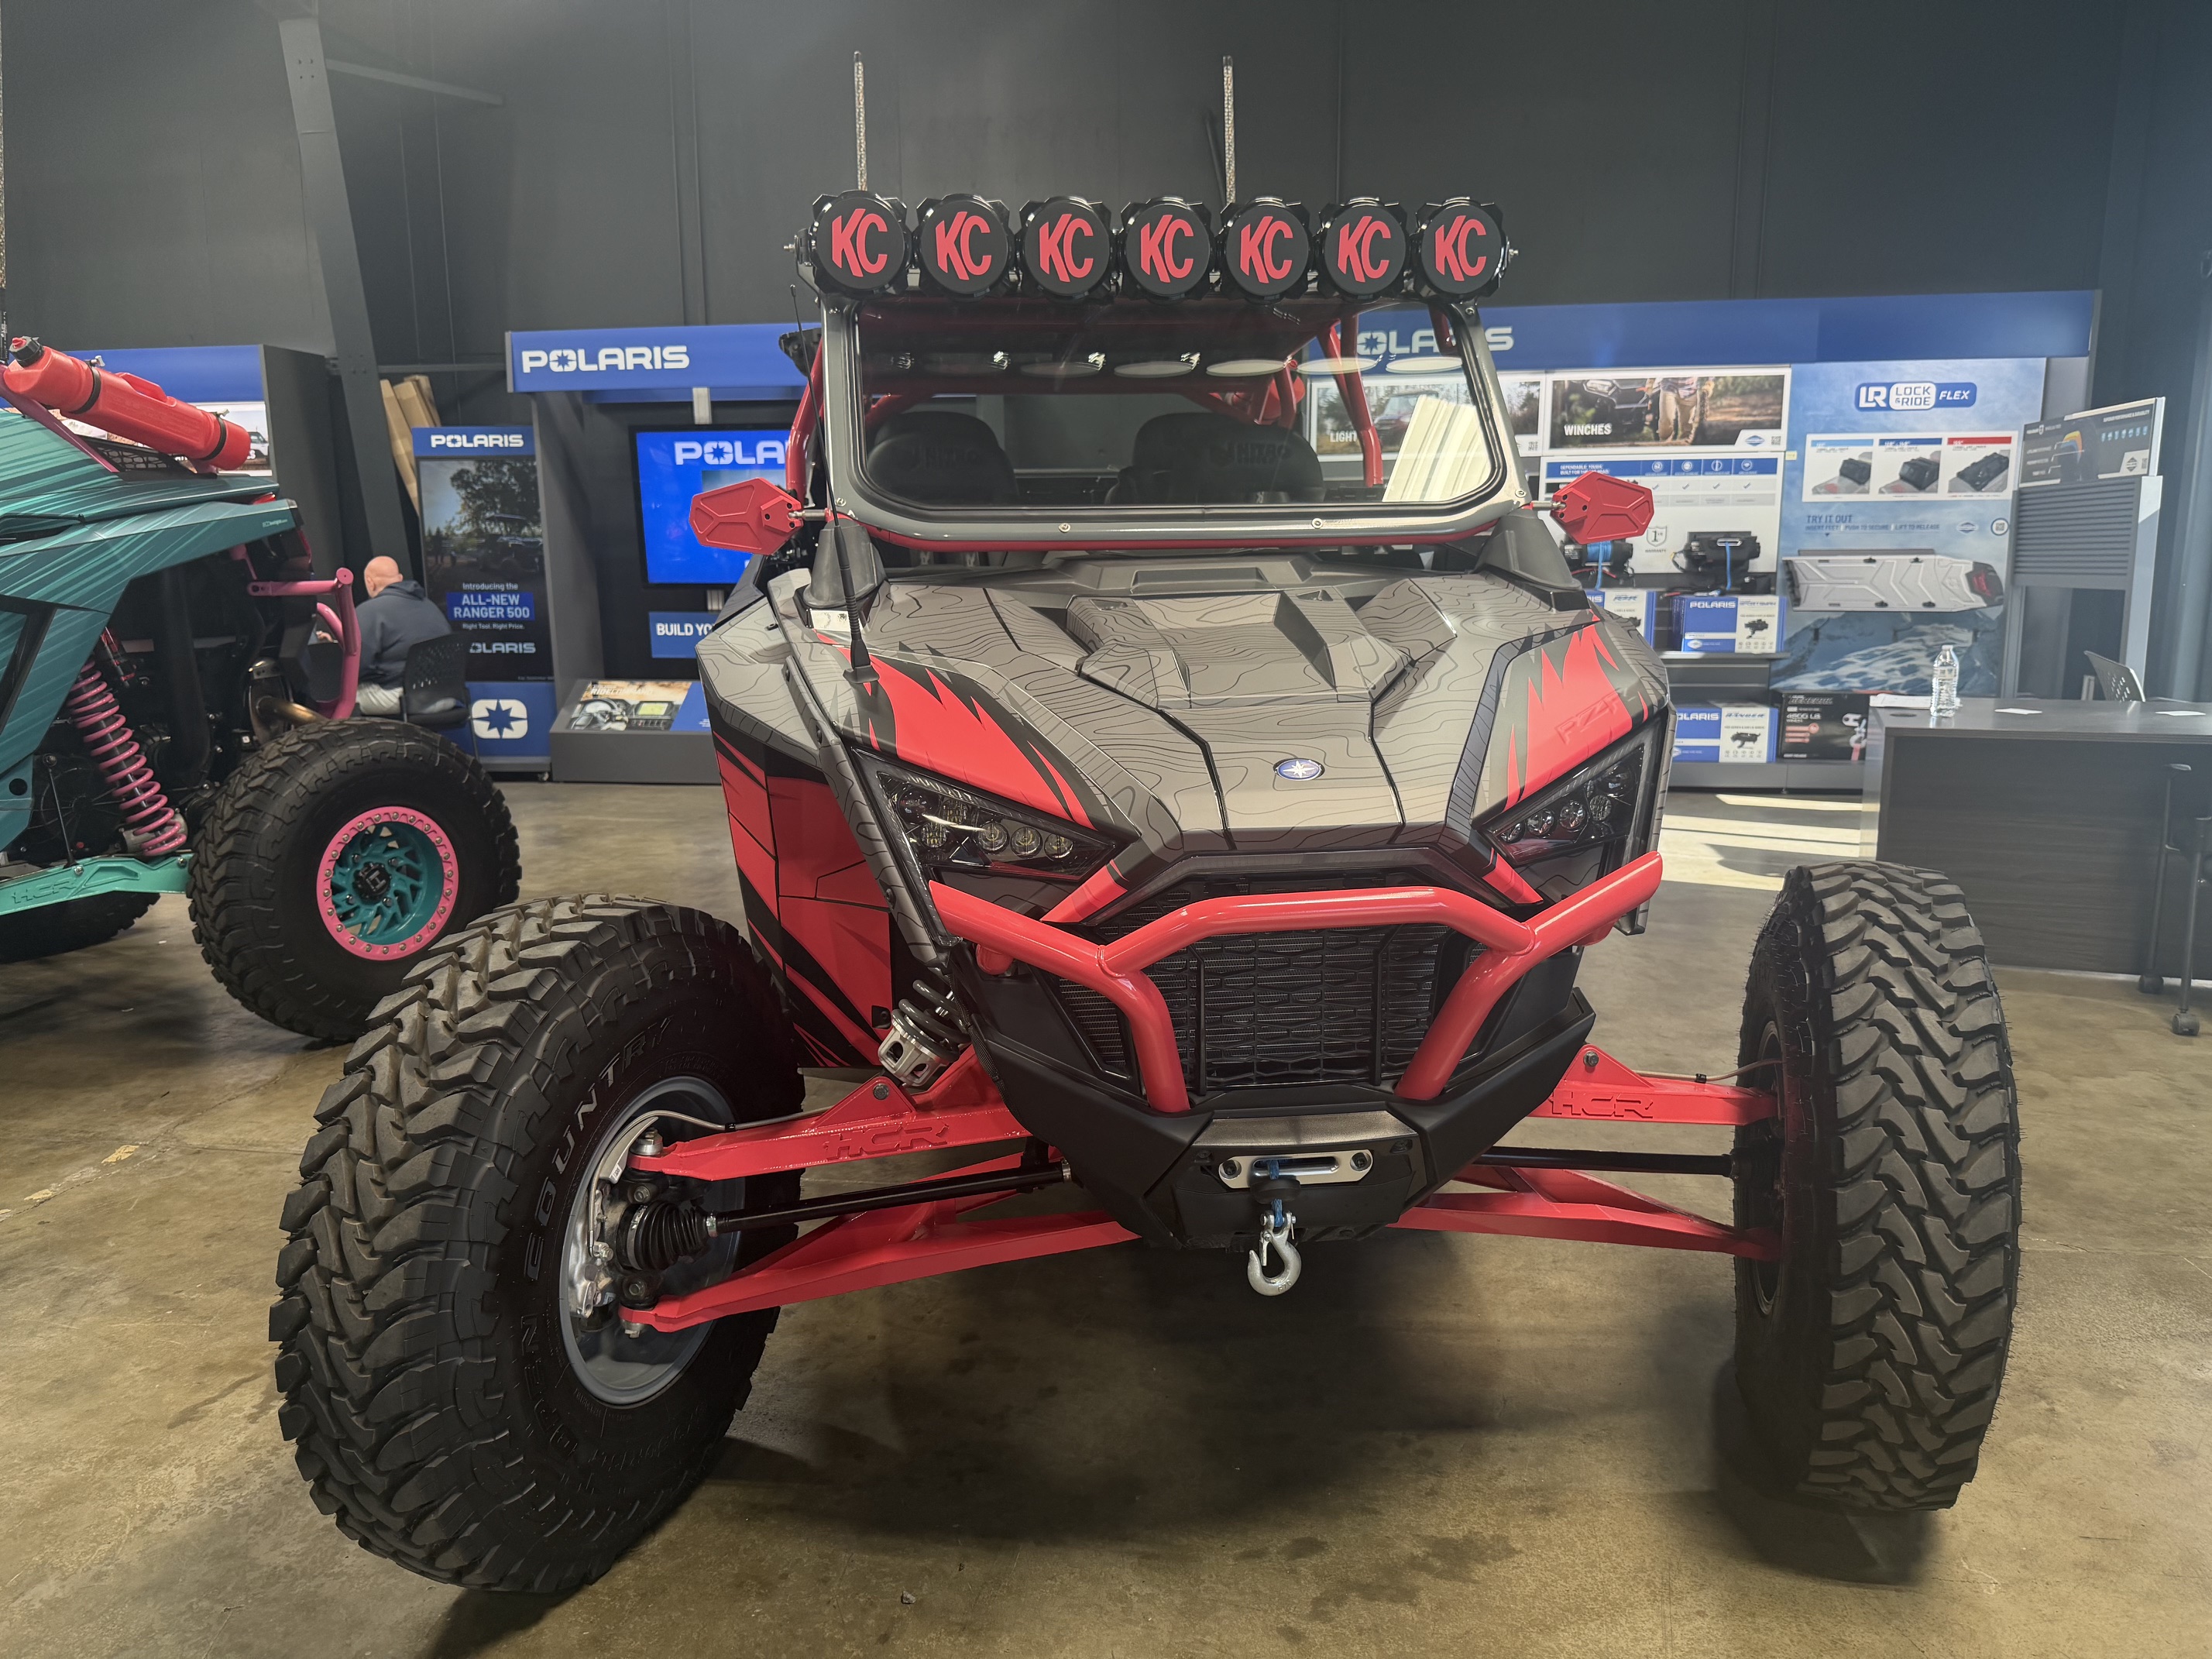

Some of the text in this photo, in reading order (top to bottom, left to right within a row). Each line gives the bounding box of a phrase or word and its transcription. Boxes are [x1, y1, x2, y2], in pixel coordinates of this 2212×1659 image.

[832, 209, 888, 277] KC
[936, 211, 992, 281] KC
[1039, 215, 1094, 283] KC
[1141, 215, 1194, 283] KC
[1338, 216, 1390, 283] KC
[1436, 216, 1487, 281] KC
[1241, 216, 1293, 284] KC
[1338, 325, 1515, 356] OLAS
[522, 345, 690, 373] POLARIS
[1895, 386, 1931, 396] LOCK
[1939, 390, 1970, 400] FLEX
[1330, 430, 1358, 442] LIGHT
[1564, 423, 1613, 436] WINCHES
[431, 434, 524, 448] POLARIS
[675, 440, 789, 465] POLA
[1807, 514, 1853, 524] TRY IT OUT
[462, 582, 504, 591] Introducing
[462, 593, 520, 606] ALL-NEW
[1690, 600, 1737, 609] POLARIS
[454, 606, 530, 618] RANGER 500
[656, 623, 714, 636] BUILD YO
[469, 642, 536, 654] OLARIS
[1676, 713, 1719, 721] OLARIS
[823, 1123, 950, 1161] HCR
